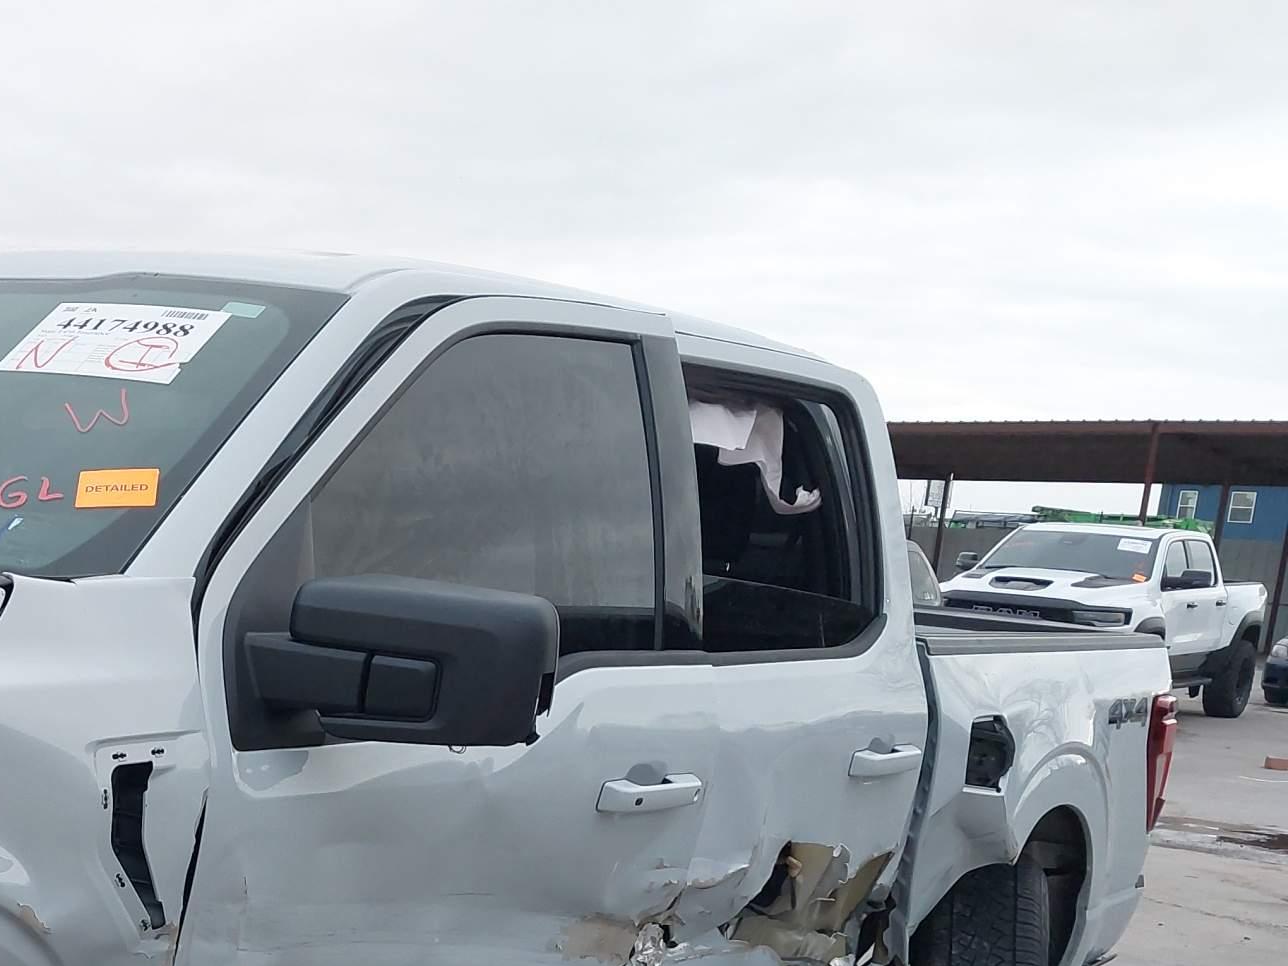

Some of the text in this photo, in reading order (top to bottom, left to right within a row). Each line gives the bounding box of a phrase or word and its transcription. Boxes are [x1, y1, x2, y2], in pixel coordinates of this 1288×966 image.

[56, 317, 195, 337] 44174988
[64, 388, 129, 433] W
[85, 483, 149, 494] DETAILED
